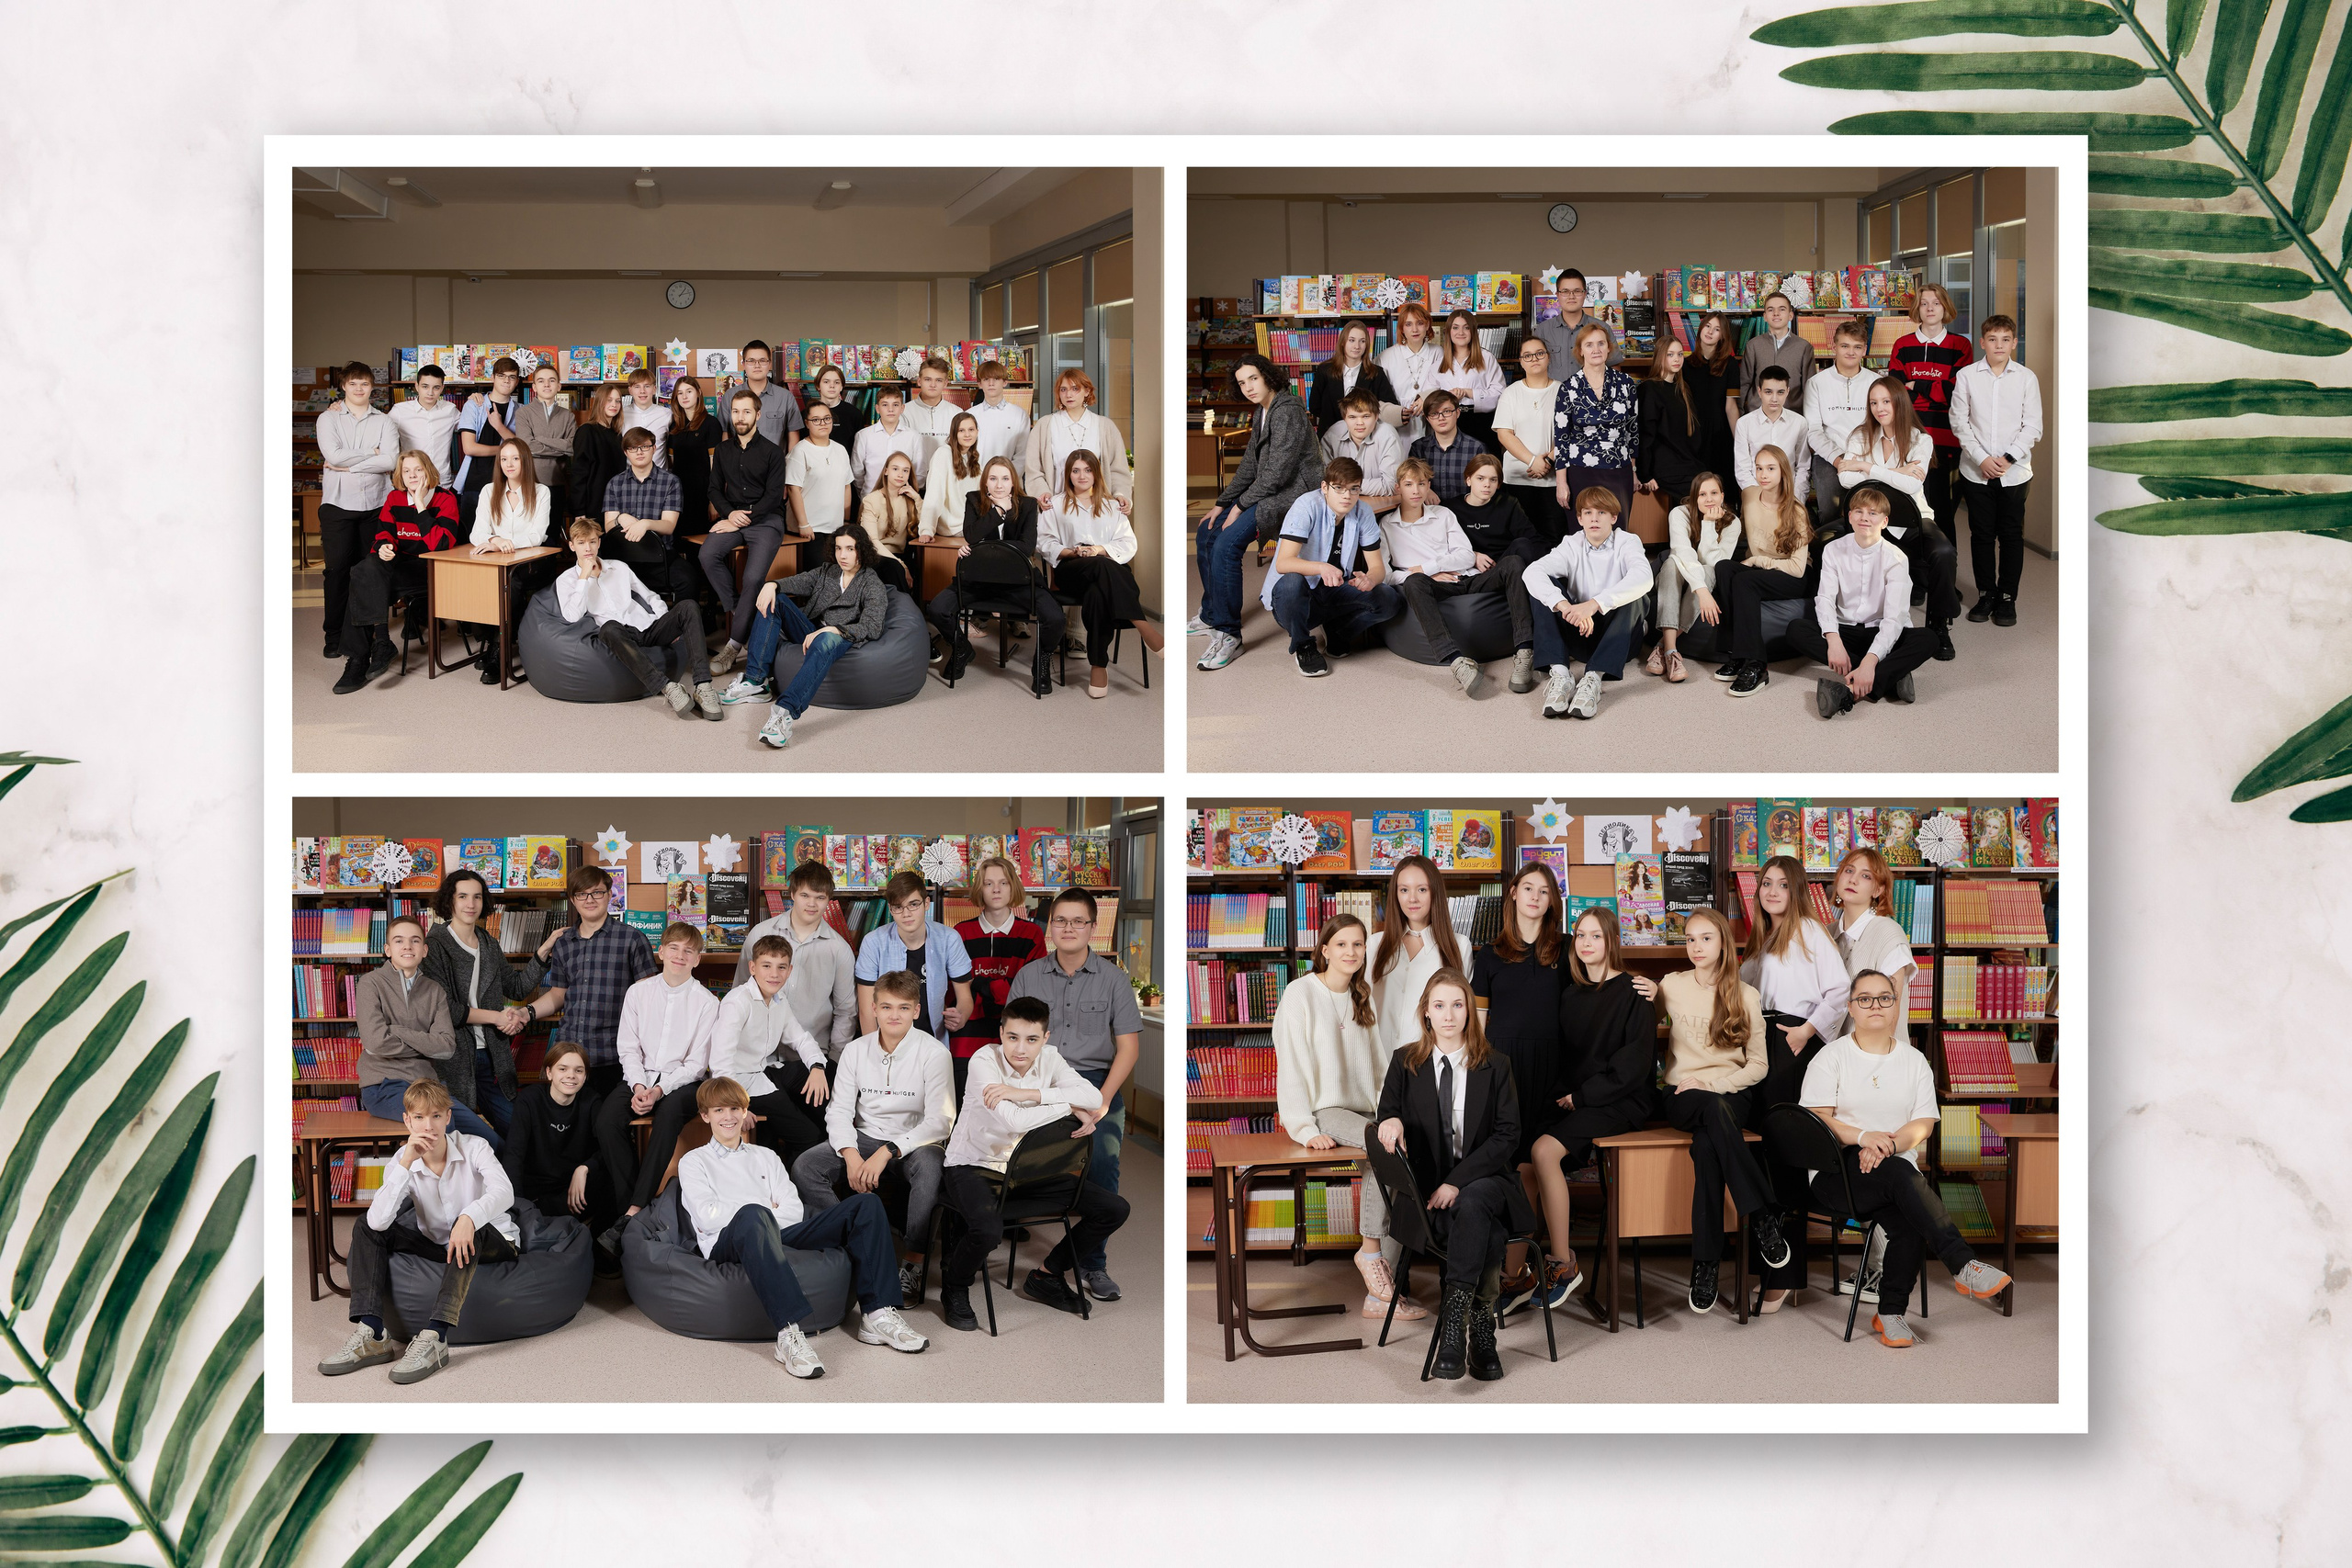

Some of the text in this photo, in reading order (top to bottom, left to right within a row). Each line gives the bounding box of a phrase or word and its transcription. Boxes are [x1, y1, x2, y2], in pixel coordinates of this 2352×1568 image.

[1599, 821, 1634, 838] ПЕРИОДИКА
[1664, 852, 1709, 865] Discovery
[708, 873, 747, 884] Discovery
[707, 914, 747, 924] Discovery
[975, 964, 1010, 976] chocolat
[1672, 1011, 1710, 1029] PATR
